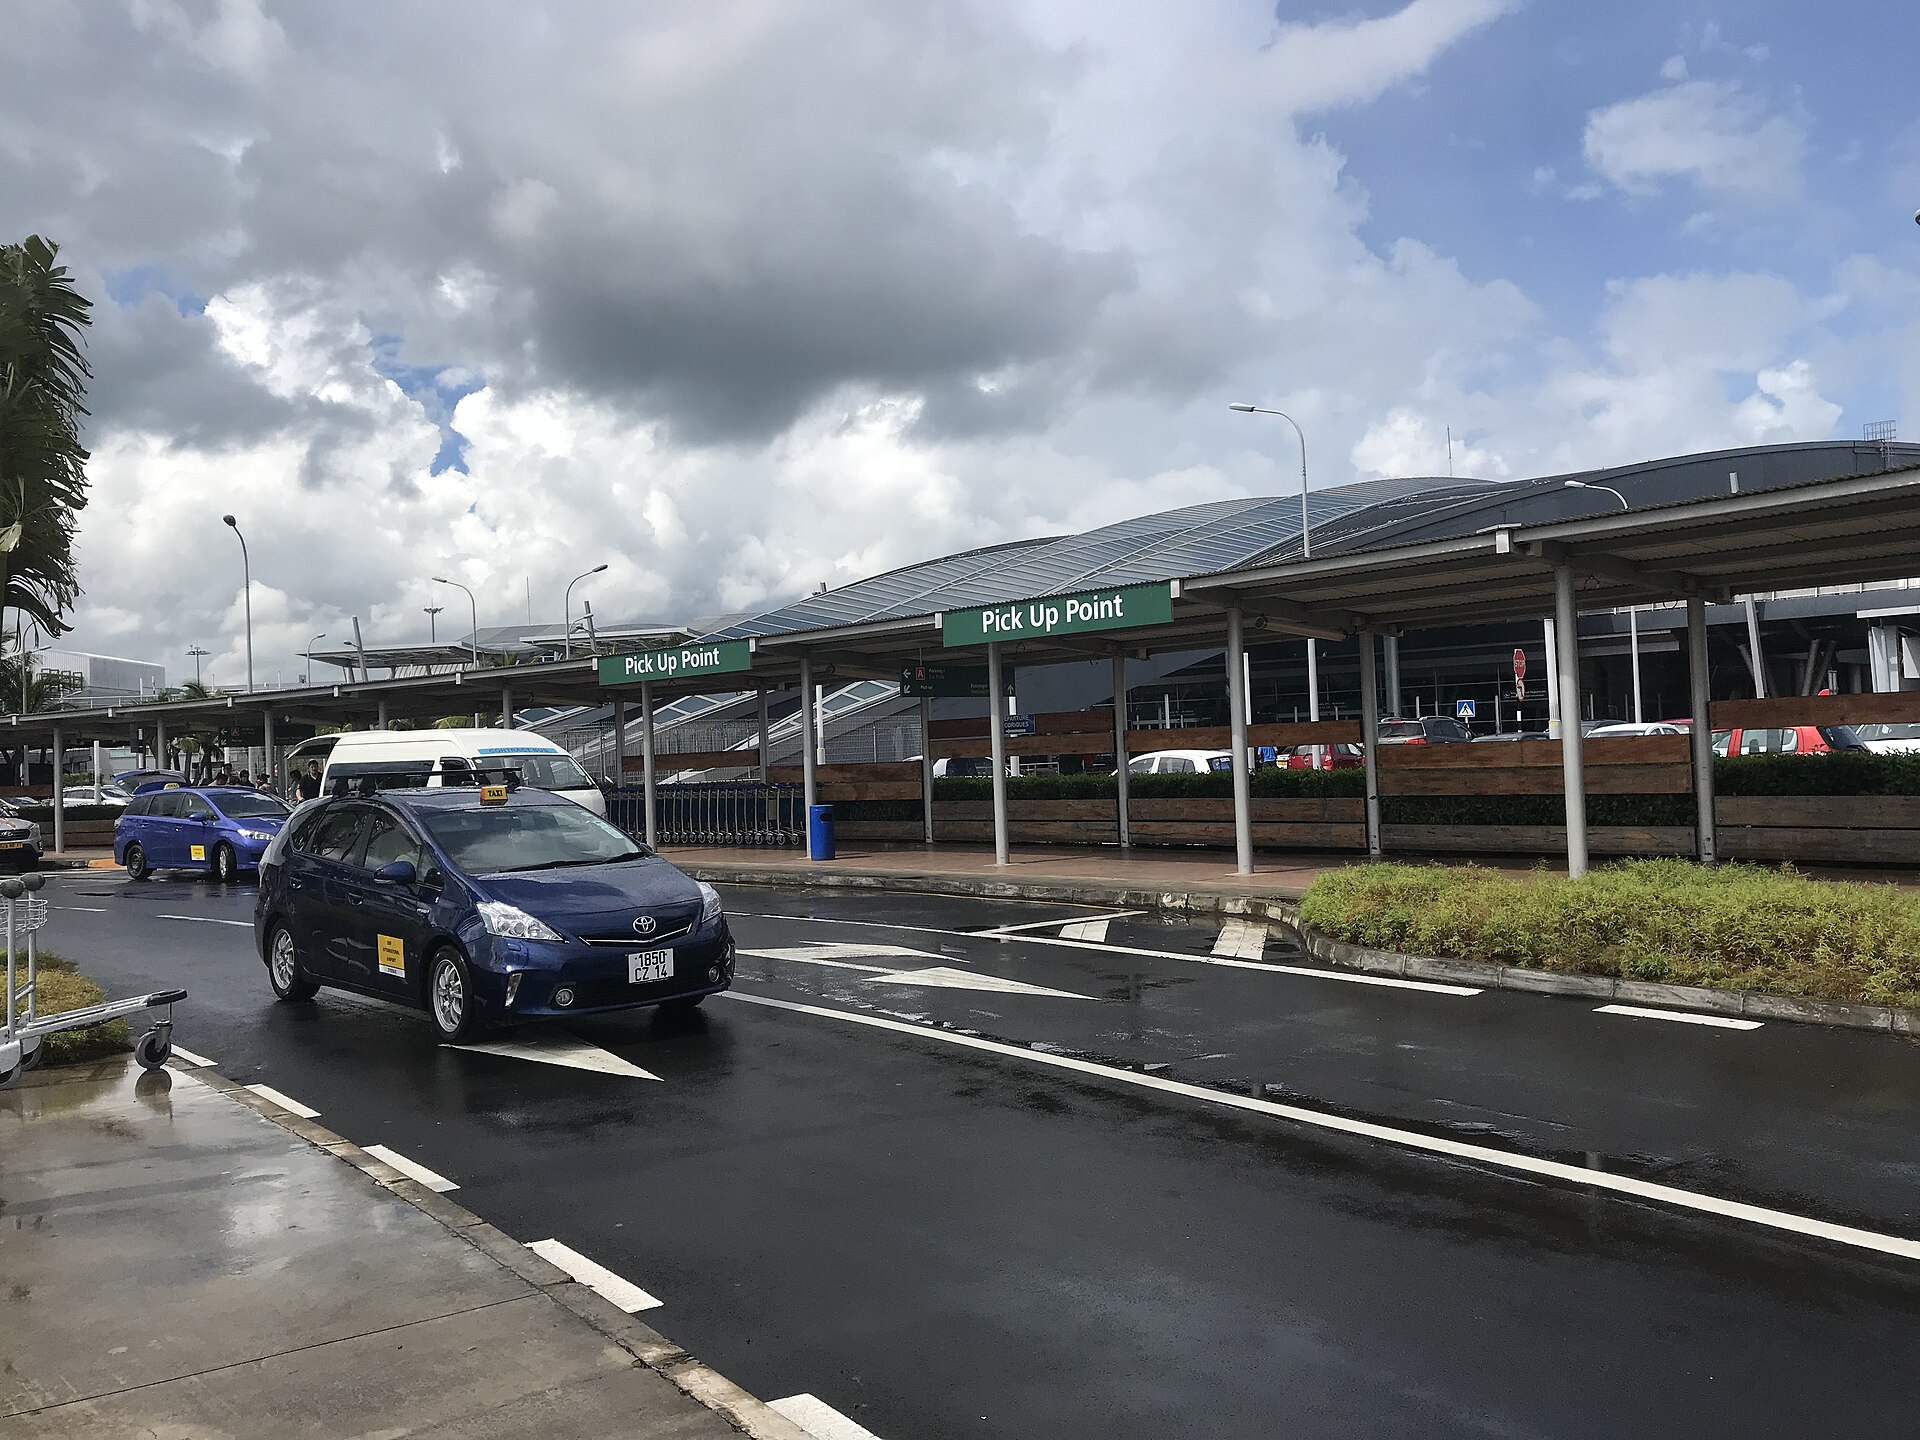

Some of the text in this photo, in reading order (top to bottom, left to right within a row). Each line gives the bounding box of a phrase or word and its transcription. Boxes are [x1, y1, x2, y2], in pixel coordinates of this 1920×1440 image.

[982, 594, 1124, 633] Pick Up Point
[625, 647, 720, 675] Pick Up Point
[1514, 659, 1525, 668] STOP
[487, 789, 503, 797] TAXI
[638, 951, 666, 968] 1850
[635, 964, 668, 982] CZ 14
